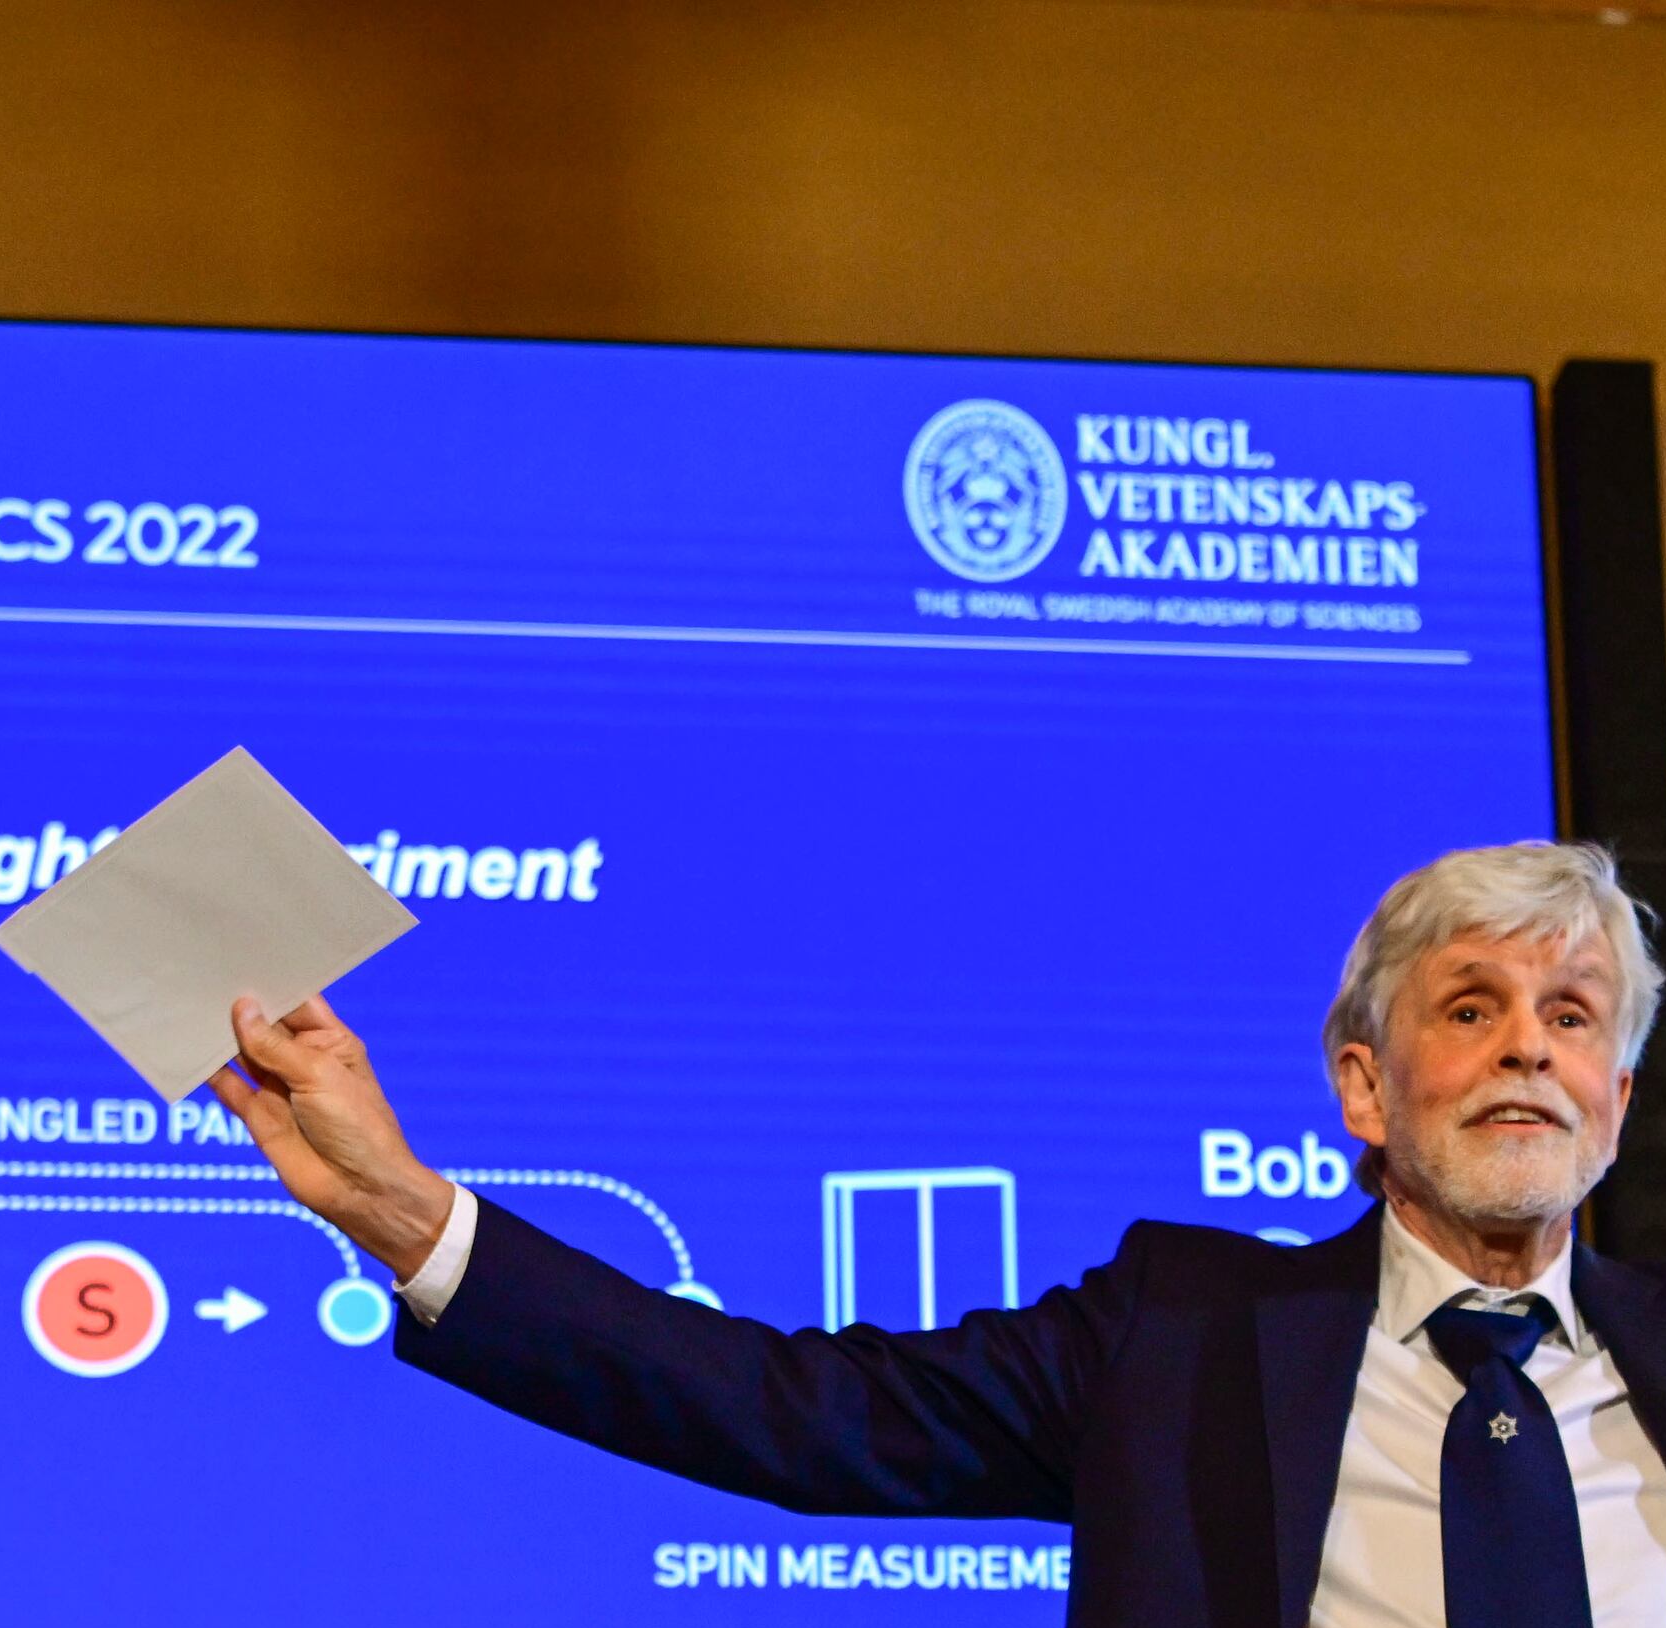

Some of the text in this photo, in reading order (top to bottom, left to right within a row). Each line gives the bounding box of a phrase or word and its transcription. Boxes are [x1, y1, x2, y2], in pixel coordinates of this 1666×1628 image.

[1074, 412, 1276, 470] KUNGL.
[81, 499, 260, 570] 2022
[1079, 528, 1420, 588] AKADEMIEN
[914, 587, 1424, 634] THE ROYAL SWEDISH ACADEMY OF SCIENCES
[1198, 1127, 1352, 1201] Bob
[77, 1282, 115, 1336] S
[652, 1541, 769, 1589] SPIN
